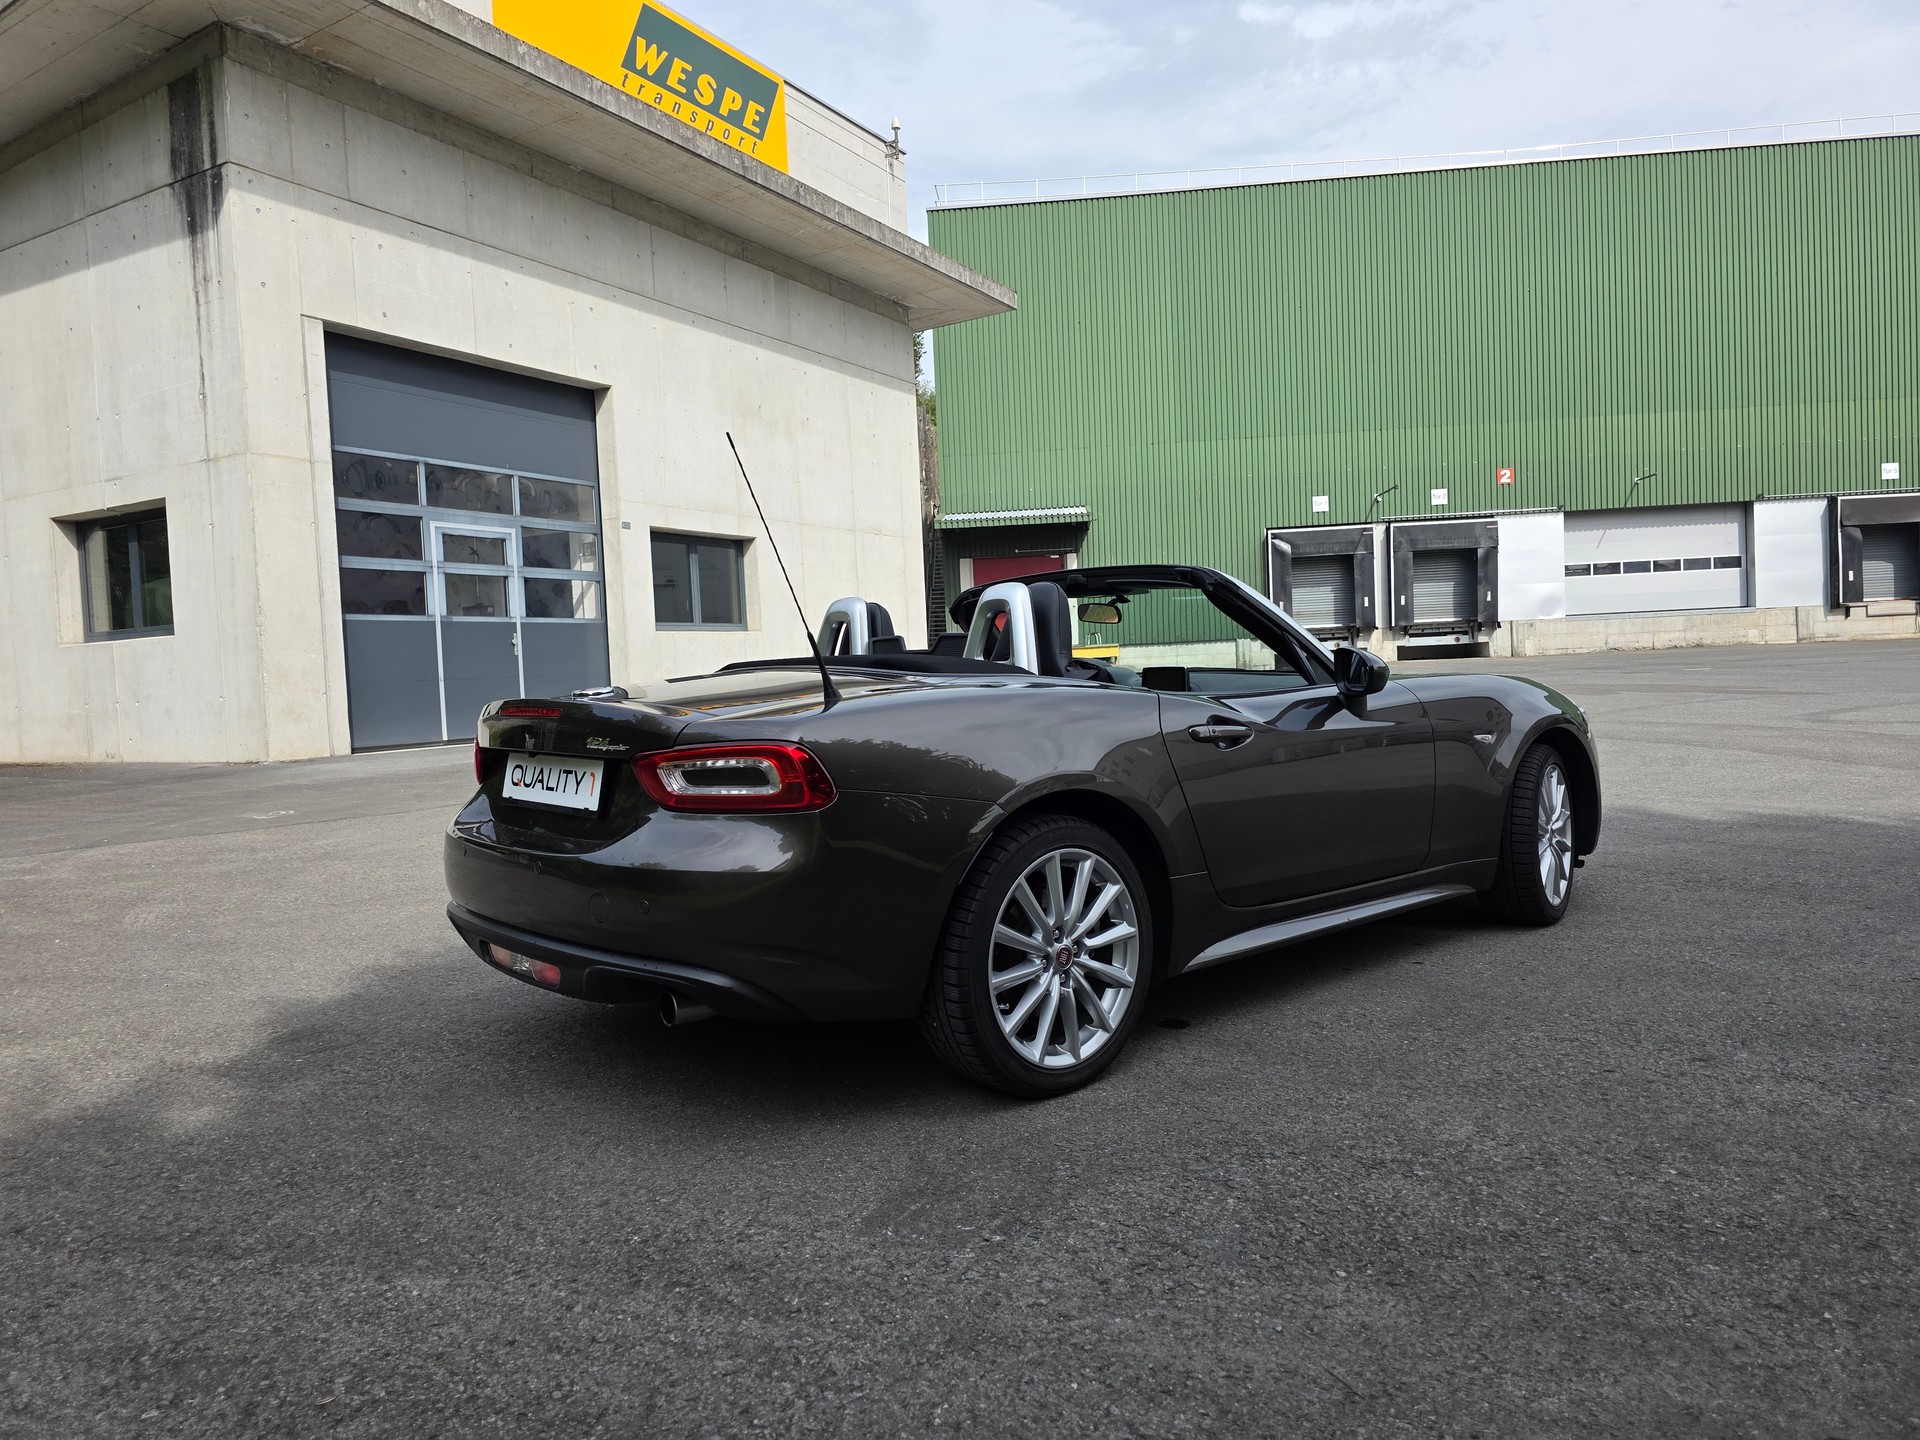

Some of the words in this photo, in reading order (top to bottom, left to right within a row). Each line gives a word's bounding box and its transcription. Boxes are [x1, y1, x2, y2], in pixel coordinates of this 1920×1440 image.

[621, 72, 758, 154] transport
[636, 35, 766, 134] WESPE
[1500, 469, 1512, 482] 2
[511, 764, 587, 795] QUALITY
[590, 771, 597, 797] 1
